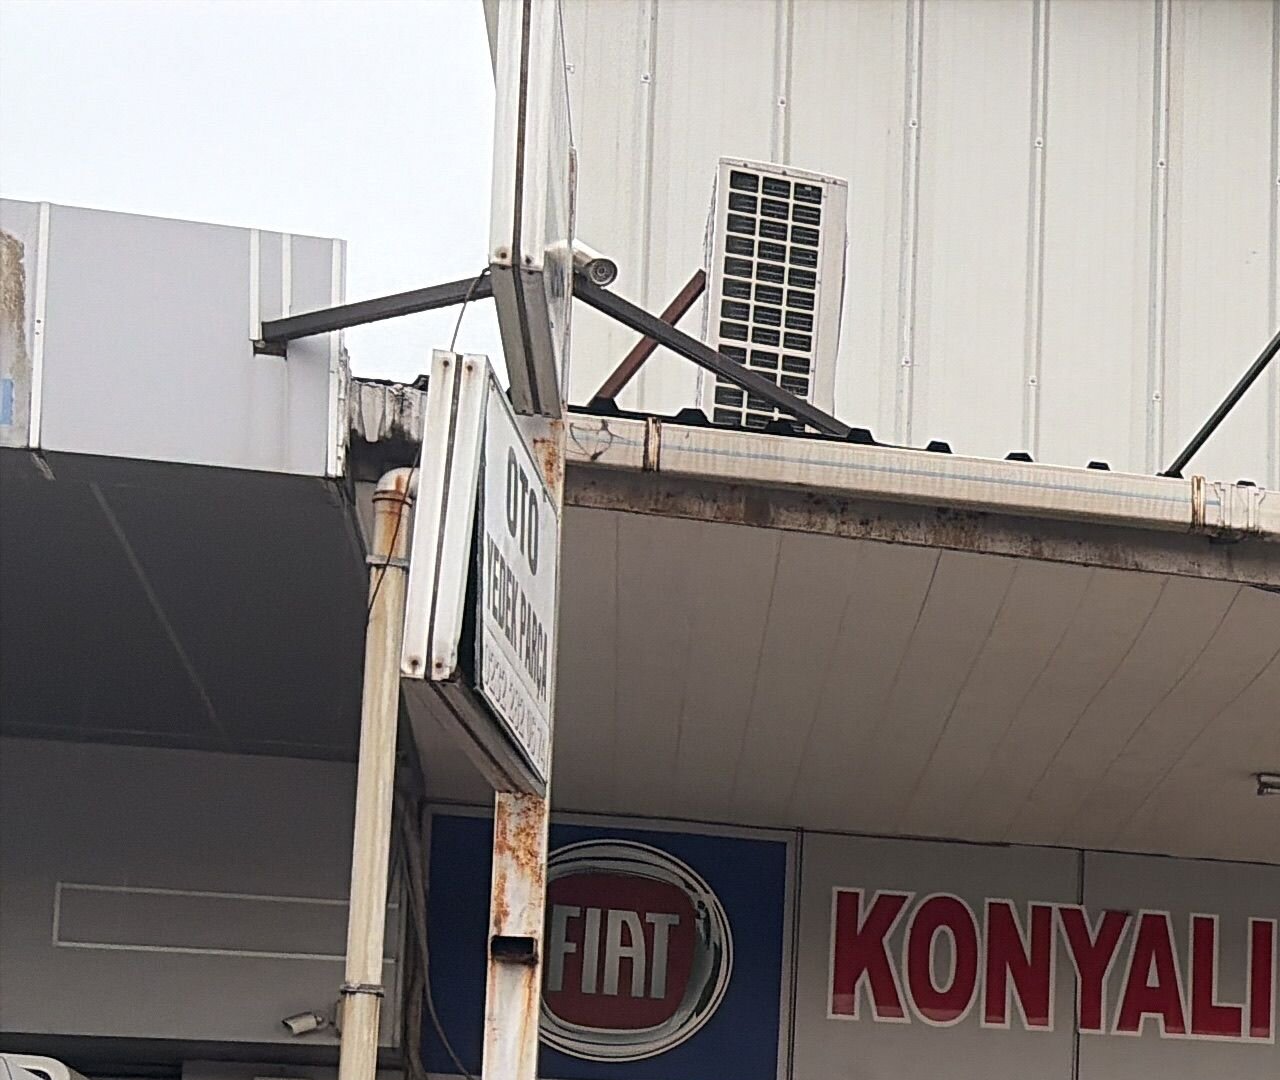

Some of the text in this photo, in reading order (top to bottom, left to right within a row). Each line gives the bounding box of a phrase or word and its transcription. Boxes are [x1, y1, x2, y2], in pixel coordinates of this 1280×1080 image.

[506, 446, 539, 577] OTO
[549, 903, 680, 1000] FIAT
[826, 884, 1278, 1048] KONYALI
